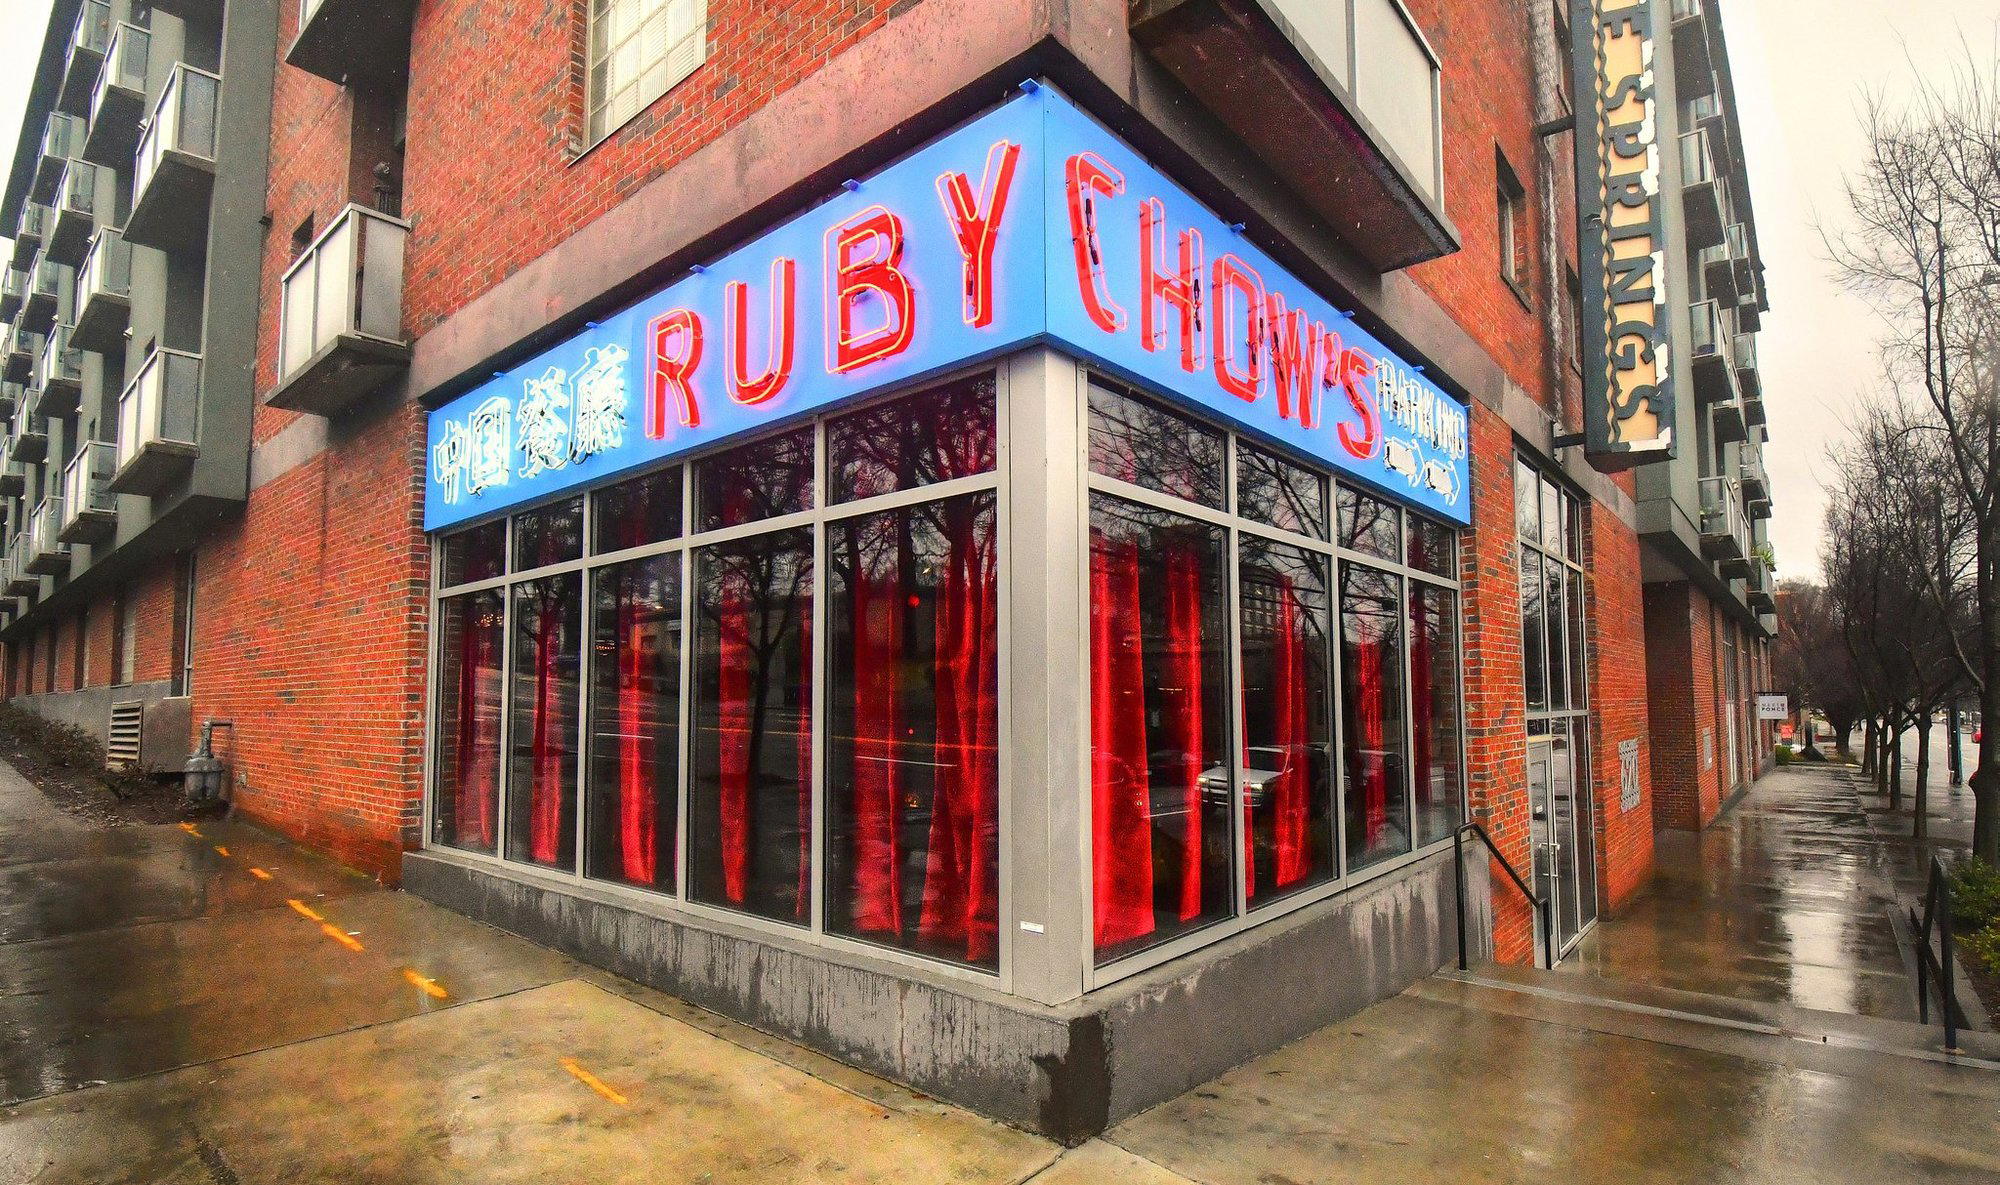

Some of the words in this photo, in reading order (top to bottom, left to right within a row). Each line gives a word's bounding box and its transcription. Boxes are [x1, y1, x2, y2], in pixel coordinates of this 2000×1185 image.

[645, 139, 1021, 439] RUBY
[1065, 151, 1381, 460] CHOW'S
[1602, 73, 1666, 421] SPRINGS
[1376, 357, 1466, 460] PARKING
